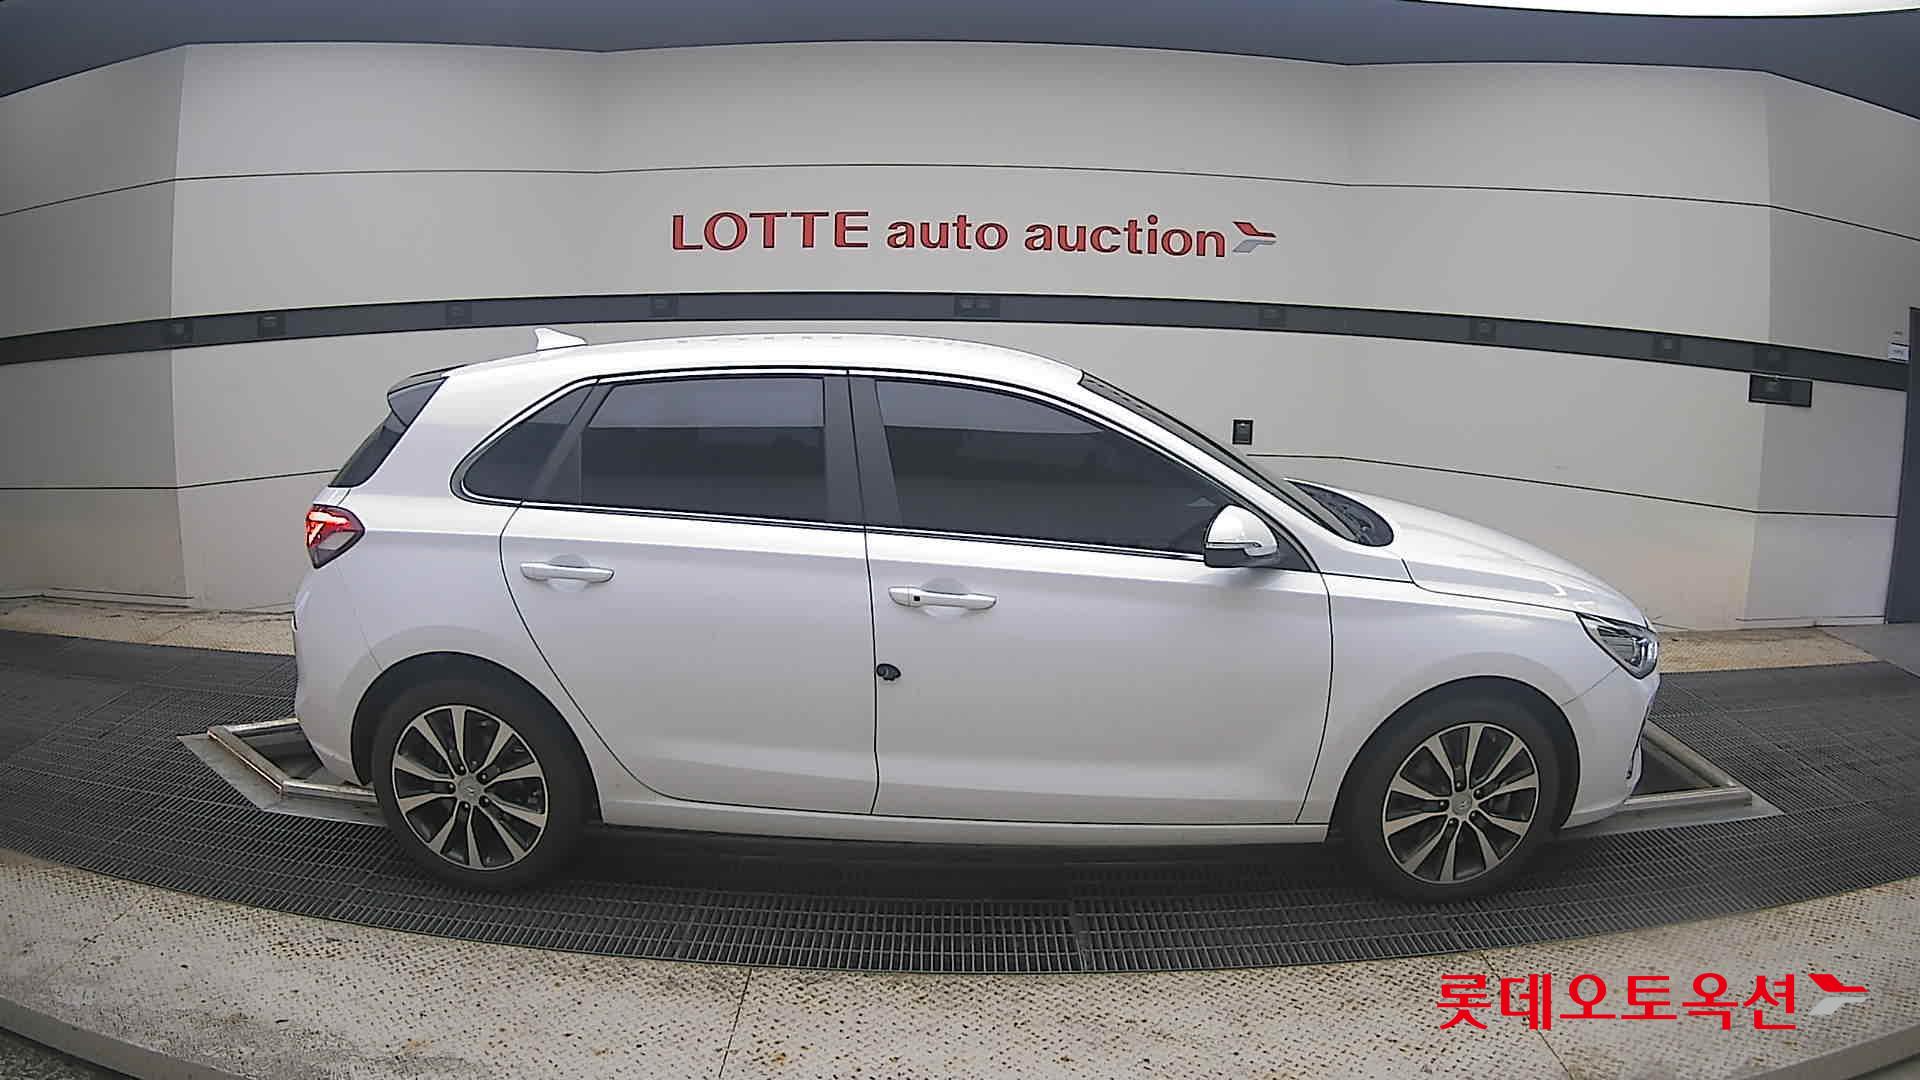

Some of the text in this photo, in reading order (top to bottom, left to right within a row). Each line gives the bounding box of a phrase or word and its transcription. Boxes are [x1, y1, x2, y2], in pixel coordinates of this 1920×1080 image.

[671, 210, 1227, 258] LOTTE auto auction
